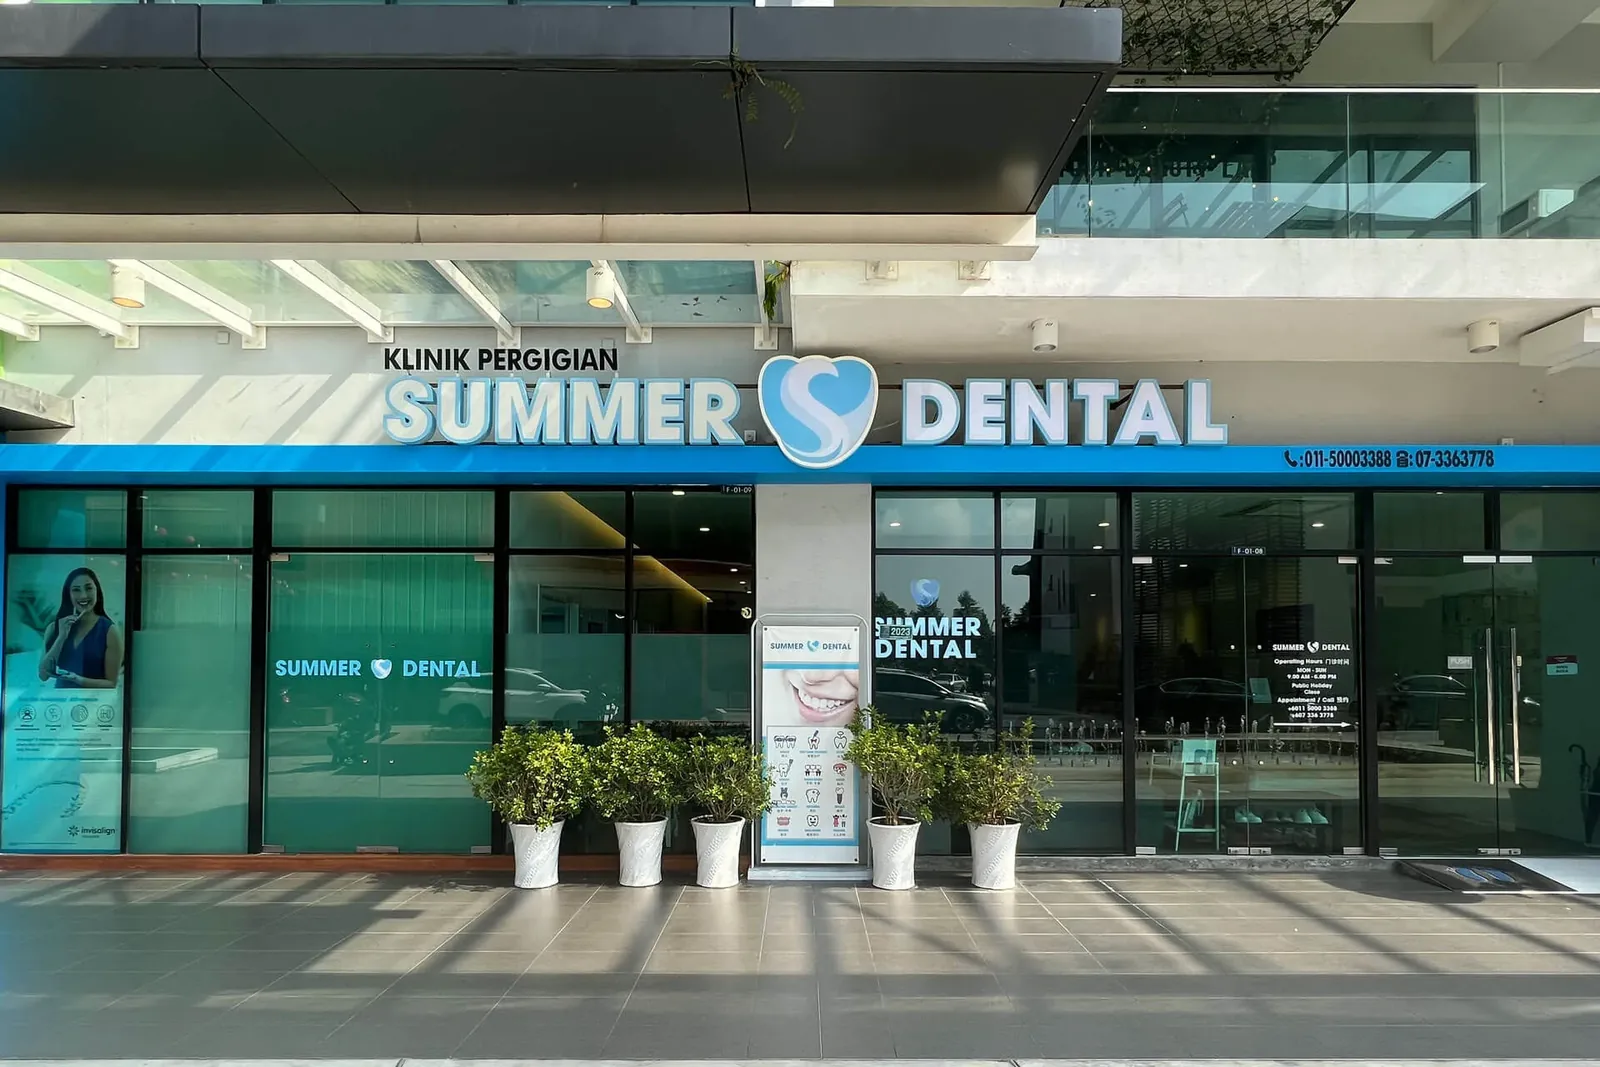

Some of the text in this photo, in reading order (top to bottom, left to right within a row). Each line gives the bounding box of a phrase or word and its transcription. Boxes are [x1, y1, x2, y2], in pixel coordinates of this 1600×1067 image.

[384, 348, 618, 371] KLINIK PERGIGIAN
[383, 377, 1229, 446] SUMMER DENTAL
[890, 627, 911, 637] 2023
[770, 642, 852, 651] SUMMER DENTAL
[875, 639, 977, 659] DENTAL
[1272, 643, 1351, 651] SUMMER DENTAL
[1274, 658, 1305, 666] Operating
[275, 659, 481, 678] SUMMER DENTAL
[1277, 696, 1316, 704] Appointment
[81, 825, 116, 836] invisalign
